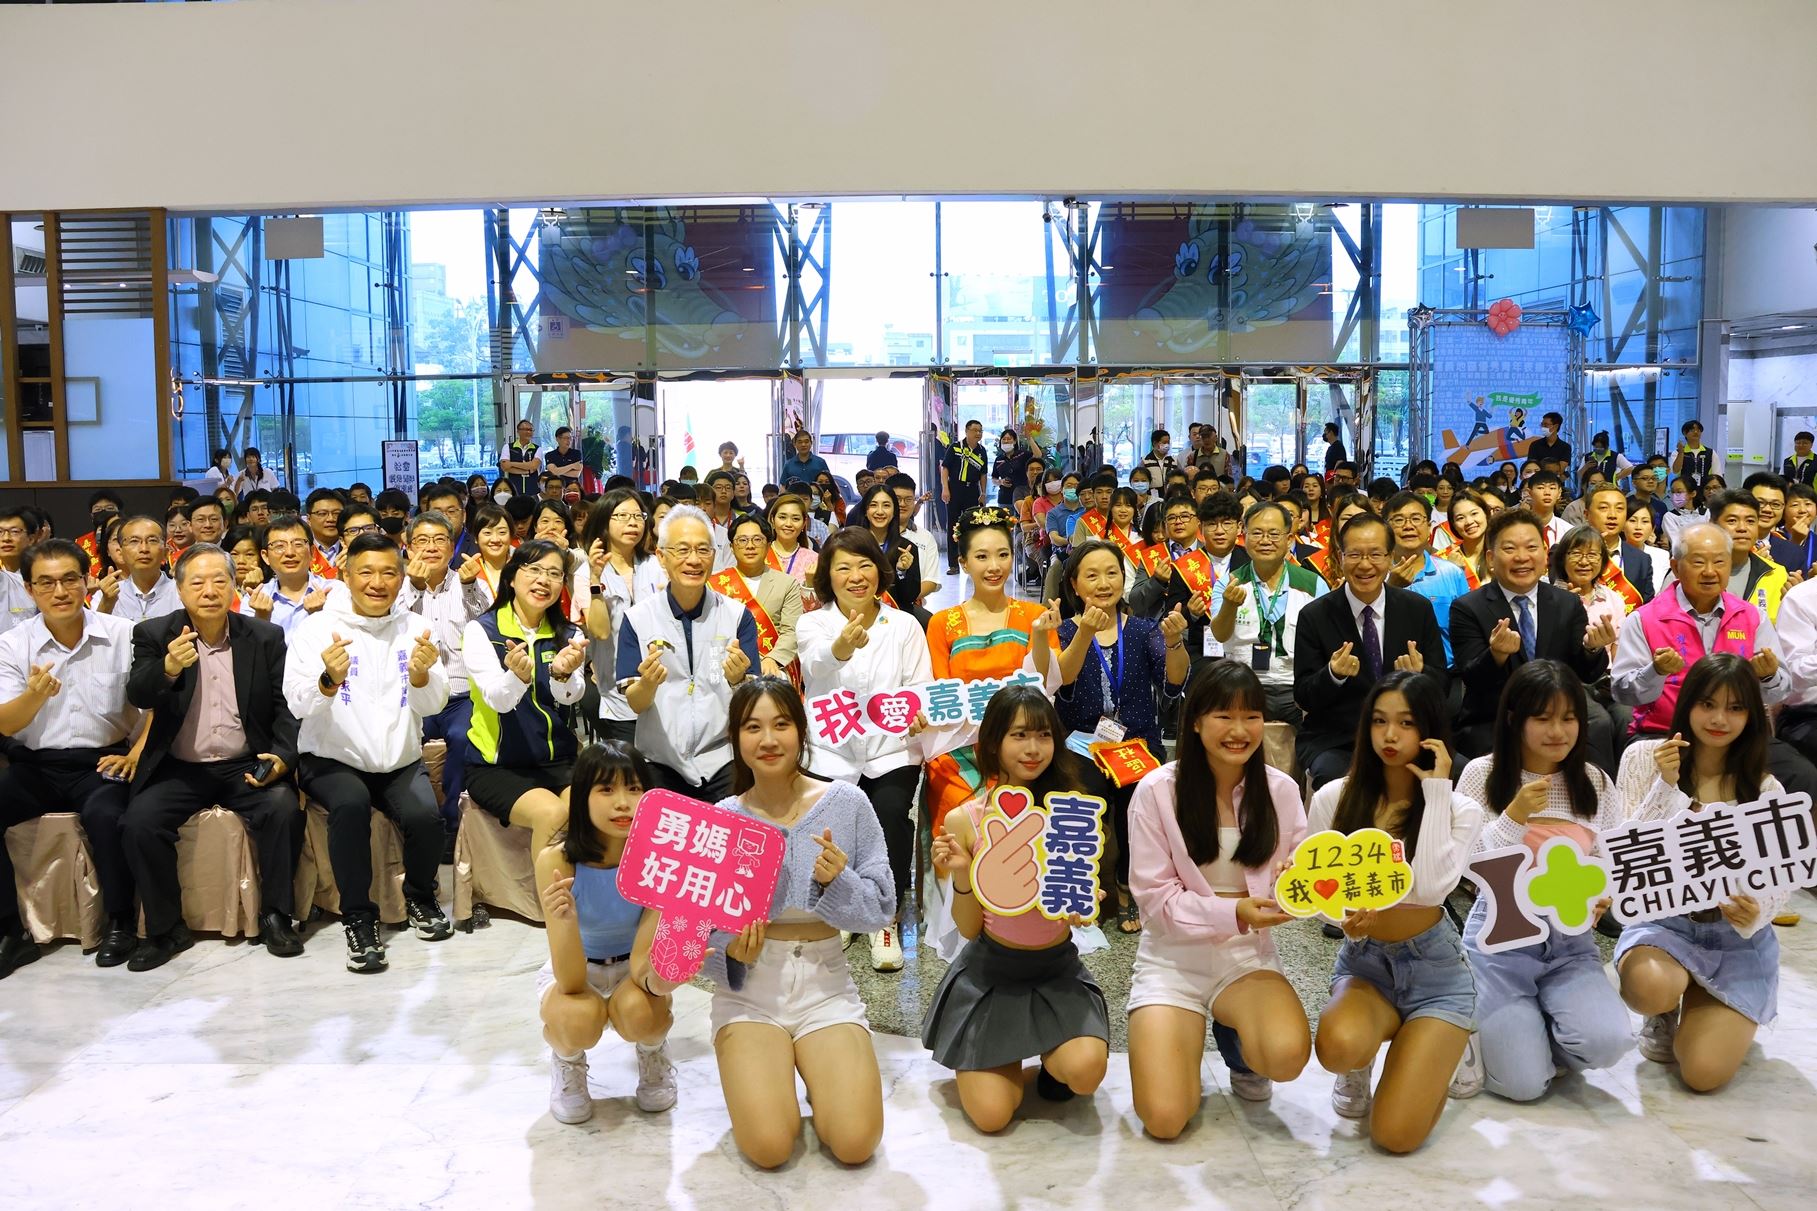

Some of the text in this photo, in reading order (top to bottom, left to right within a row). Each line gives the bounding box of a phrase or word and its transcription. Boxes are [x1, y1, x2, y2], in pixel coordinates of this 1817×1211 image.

[650, 806, 732, 865] 勇媽
[1041, 797, 1101, 916] 嘉義
[1306, 841, 1386, 871] 1234
[1605, 797, 1811, 895] 嘉義市
[637, 851, 752, 918] 好用心
[1285, 870, 1406, 904] 我 嘉義市
[1619, 857, 1817, 918] CHIAYI CITY
